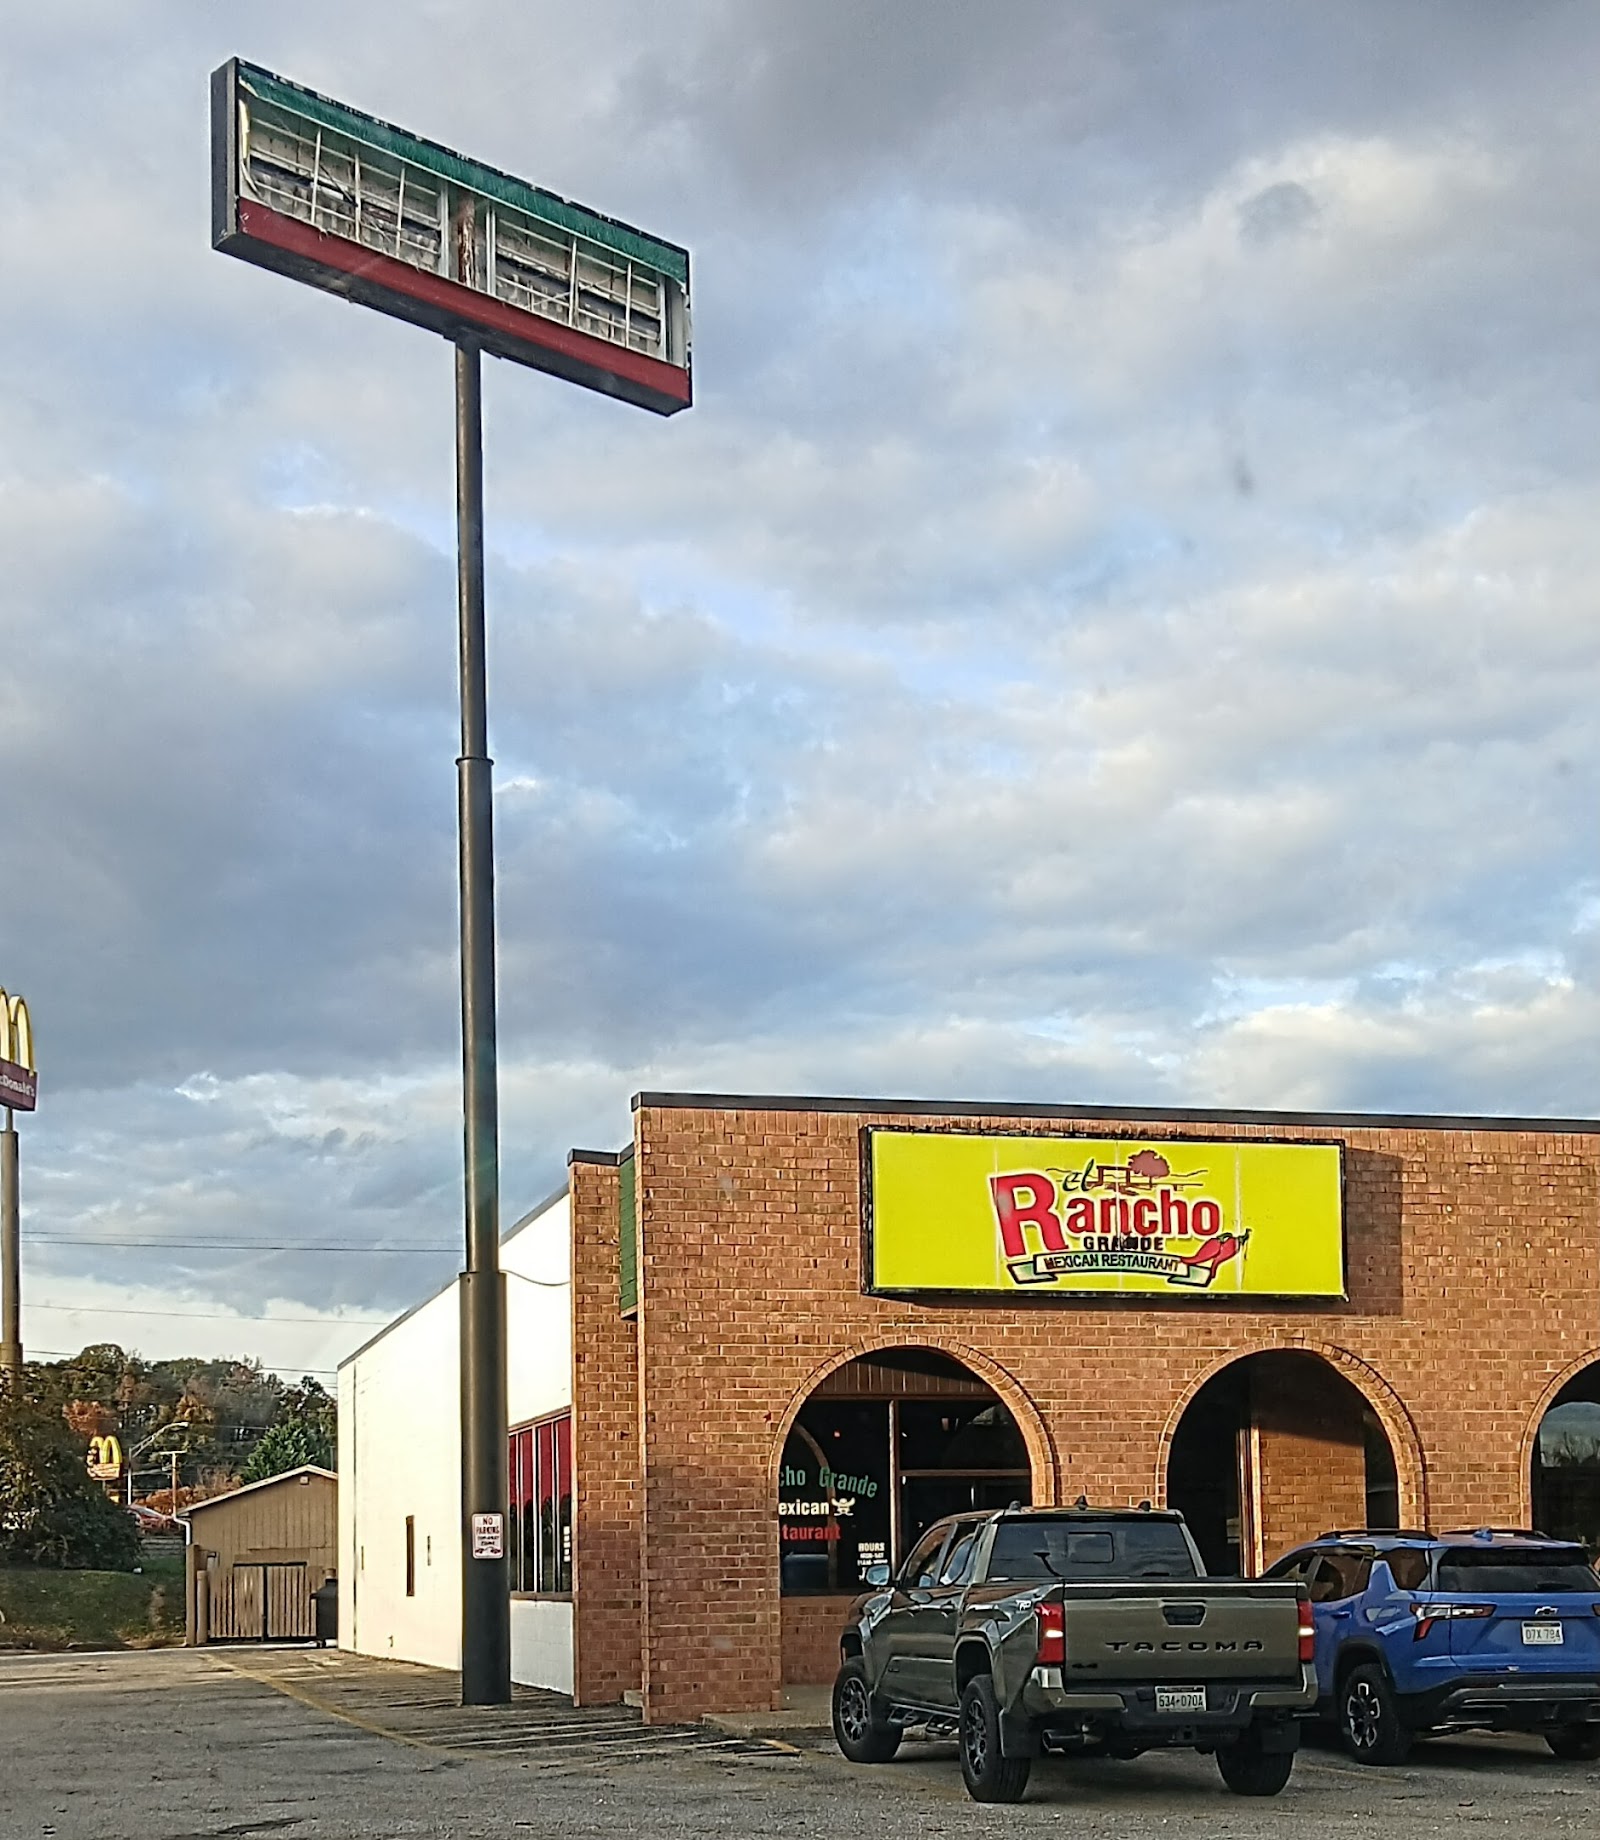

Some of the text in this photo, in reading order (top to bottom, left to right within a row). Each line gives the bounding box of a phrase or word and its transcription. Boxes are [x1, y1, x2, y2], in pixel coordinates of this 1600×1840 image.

[990, 1172, 1220, 1257] Rancho
[1083, 1235, 1164, 1251] GRADE
[1043, 1253, 1180, 1272] MEXICAN RESTAURANT
[818, 1466, 878, 1498] Grande
[482, 1517, 493, 1525] NO
[858, 1542, 885, 1552] HOURS
[1105, 1641, 1263, 1652] TACOMA
